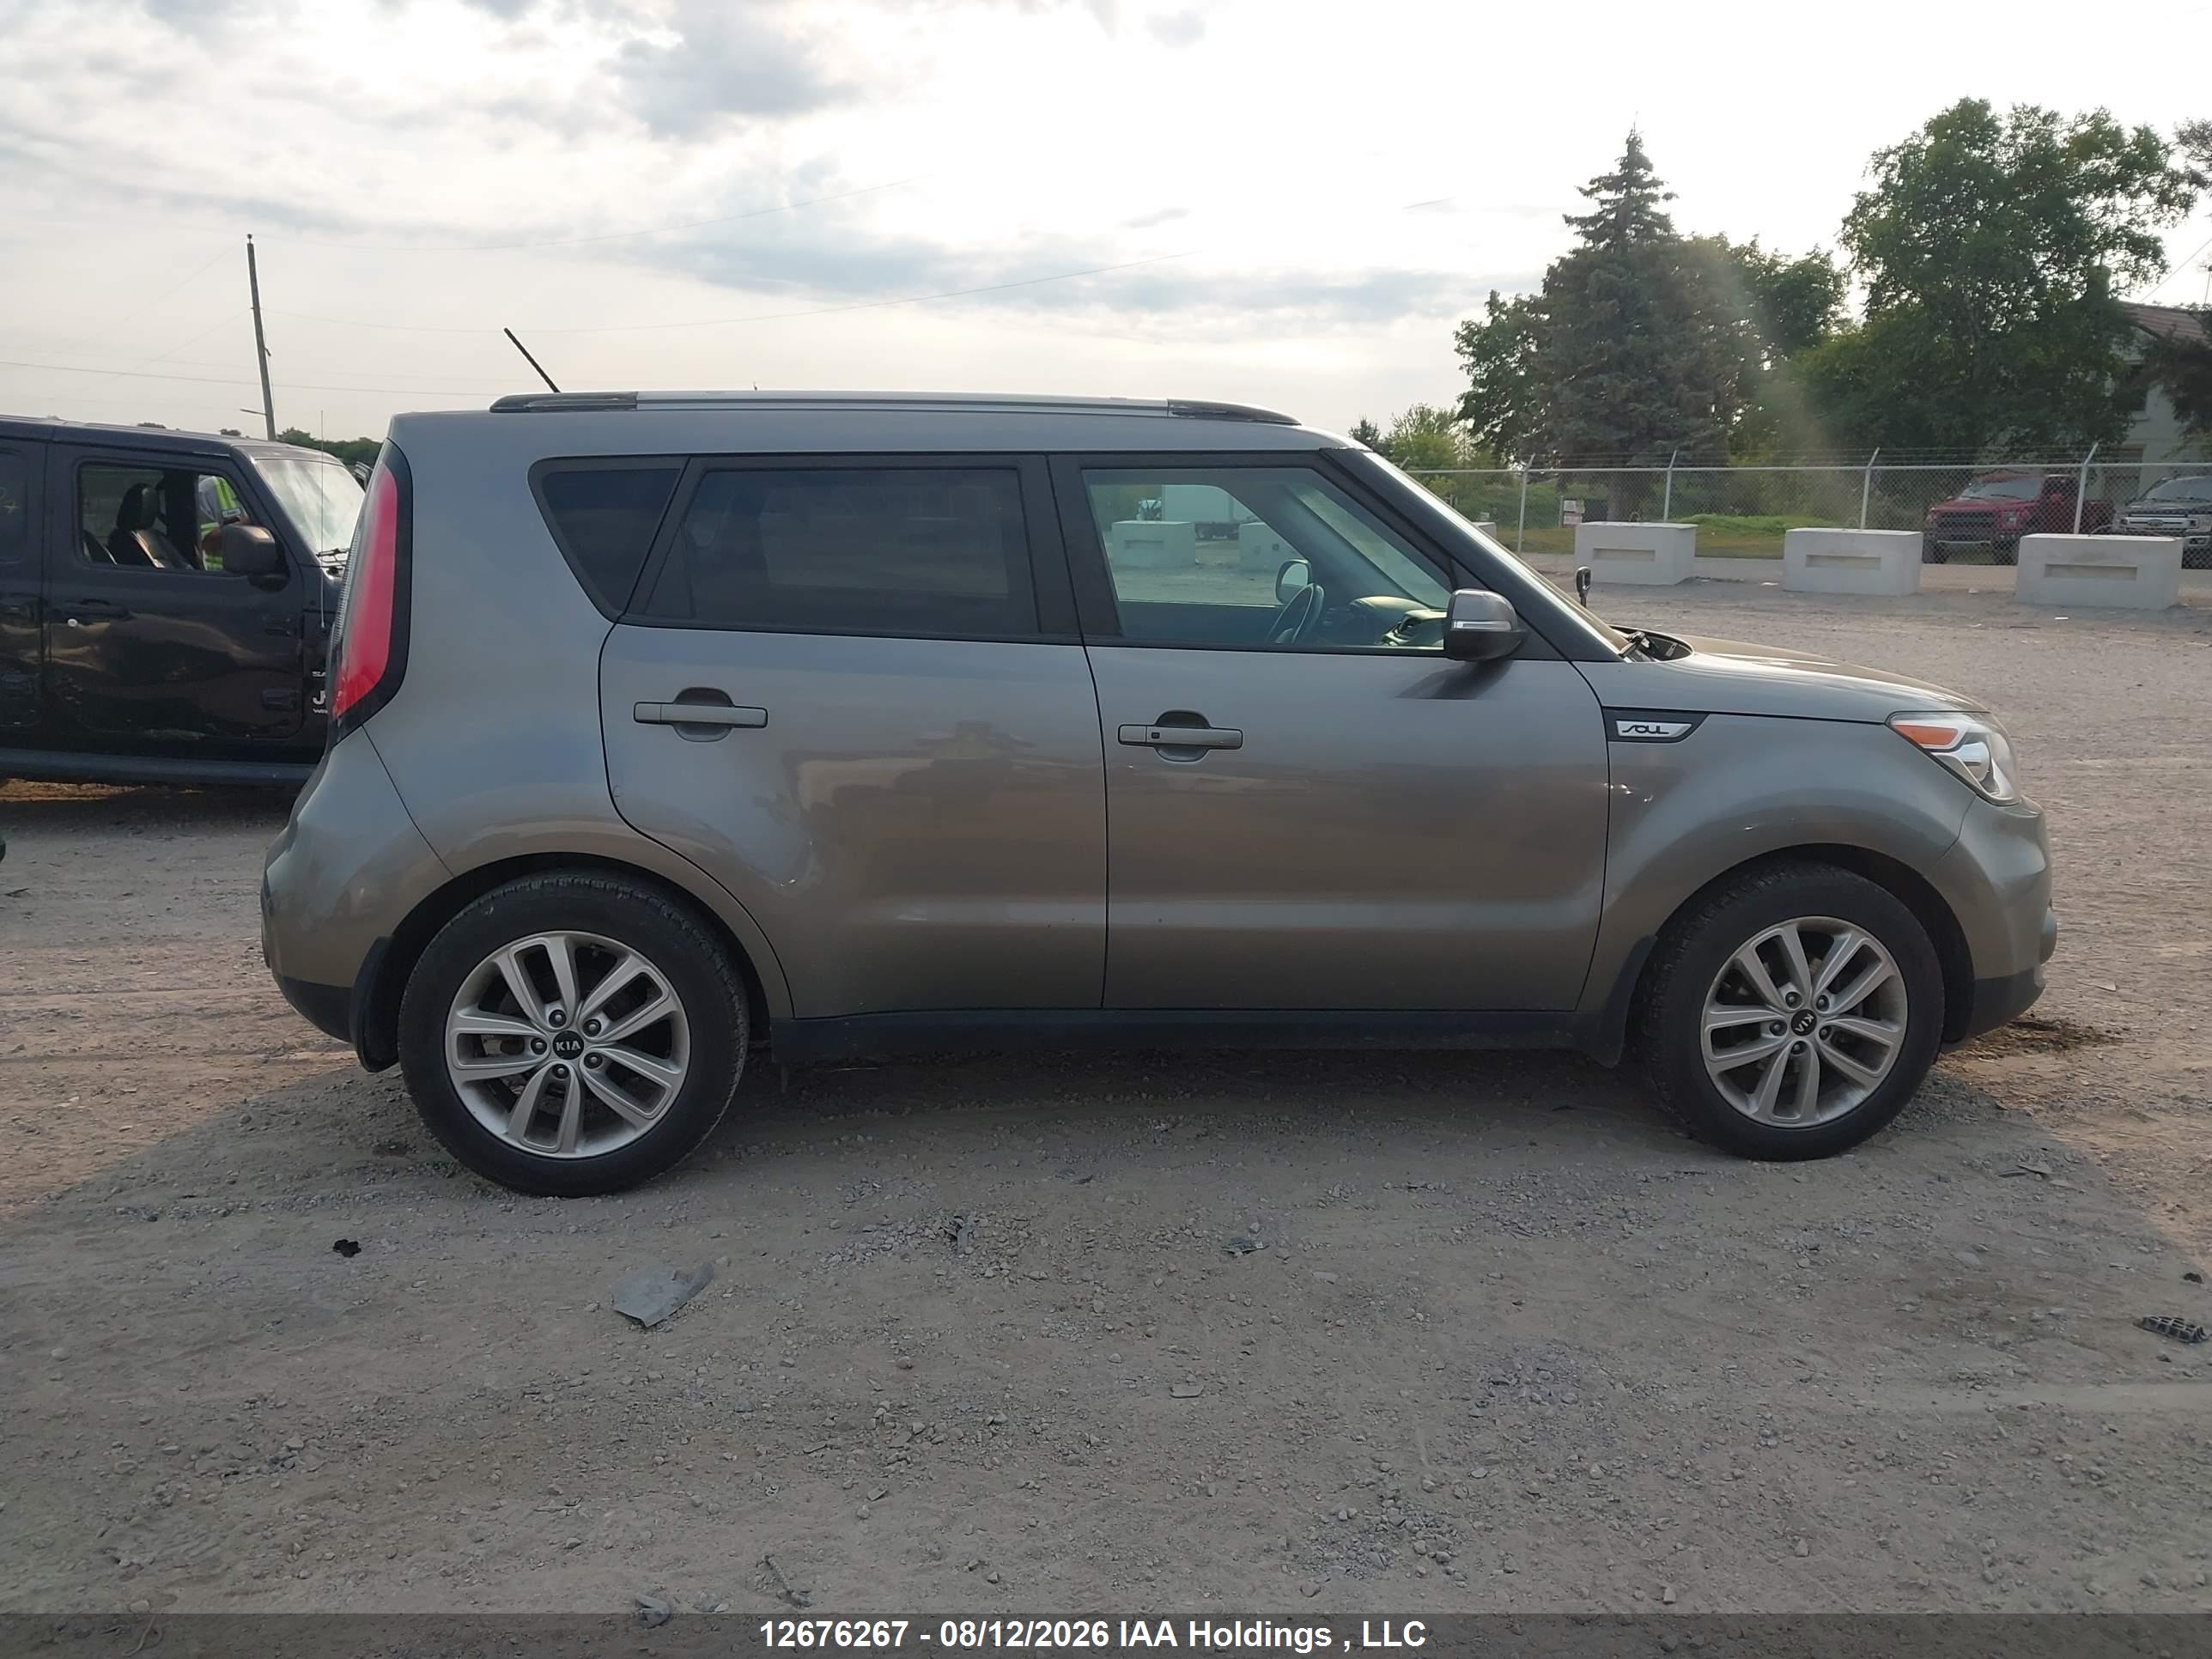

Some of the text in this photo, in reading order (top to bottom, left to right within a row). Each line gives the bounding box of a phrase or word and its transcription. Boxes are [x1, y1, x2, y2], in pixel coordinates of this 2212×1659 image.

[1621, 725, 1670, 735] SOUL
[1795, 1013, 1814, 1032] KIA
[556, 1040, 581, 1051] KIA
